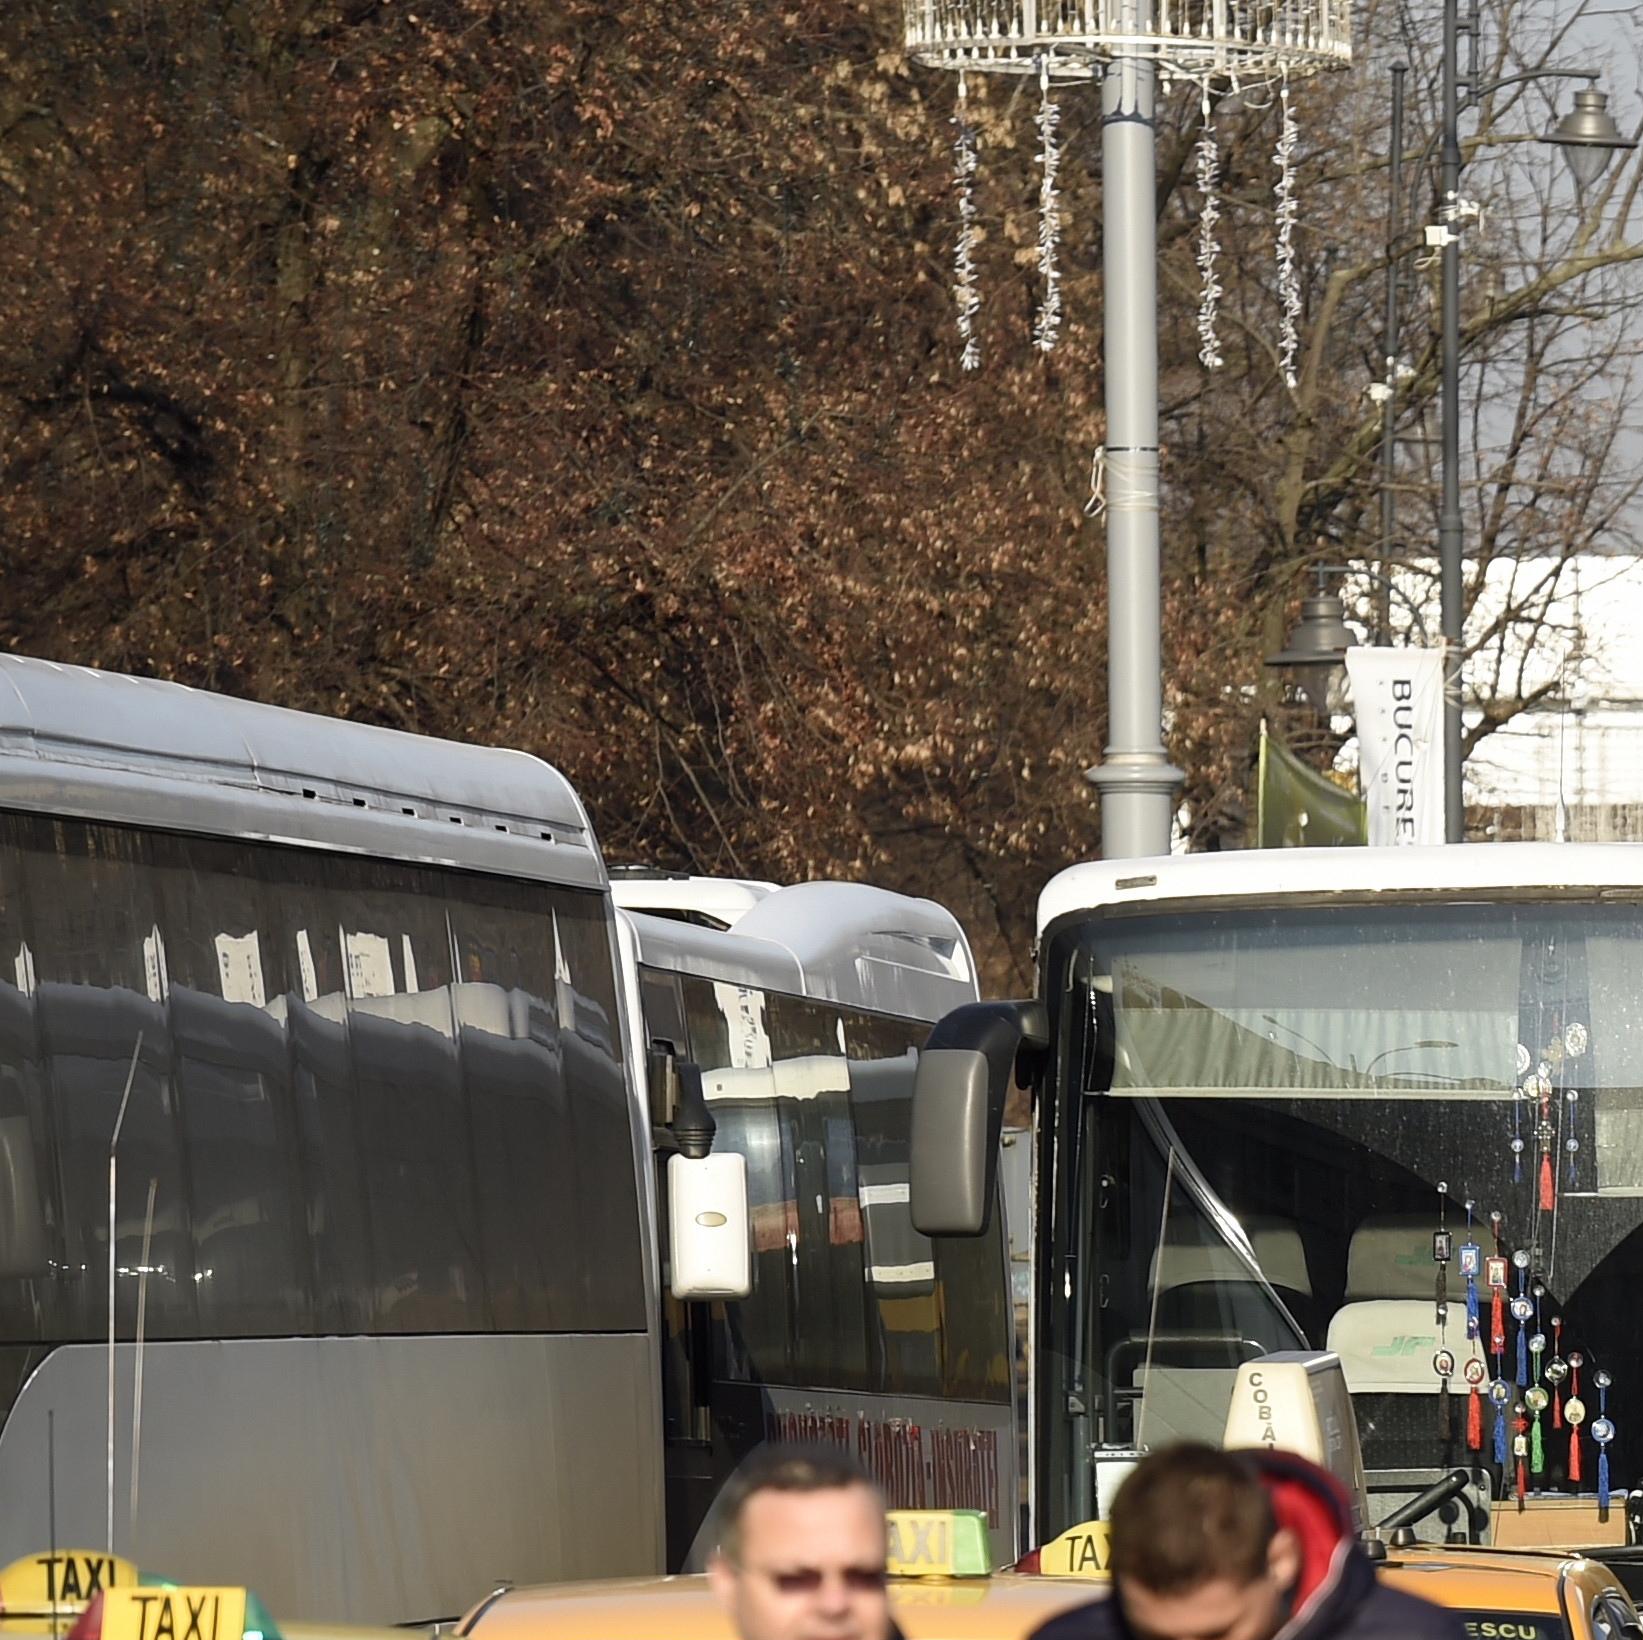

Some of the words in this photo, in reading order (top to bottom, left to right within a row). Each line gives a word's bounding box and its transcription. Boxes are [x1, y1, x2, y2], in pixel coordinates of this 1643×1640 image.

[1392, 679, 1416, 845] BUCURE
[1249, 1372, 1277, 1449] COBĂ
[886, 1520, 946, 1565] AXI
[37, 1557, 117, 1602] TAXI
